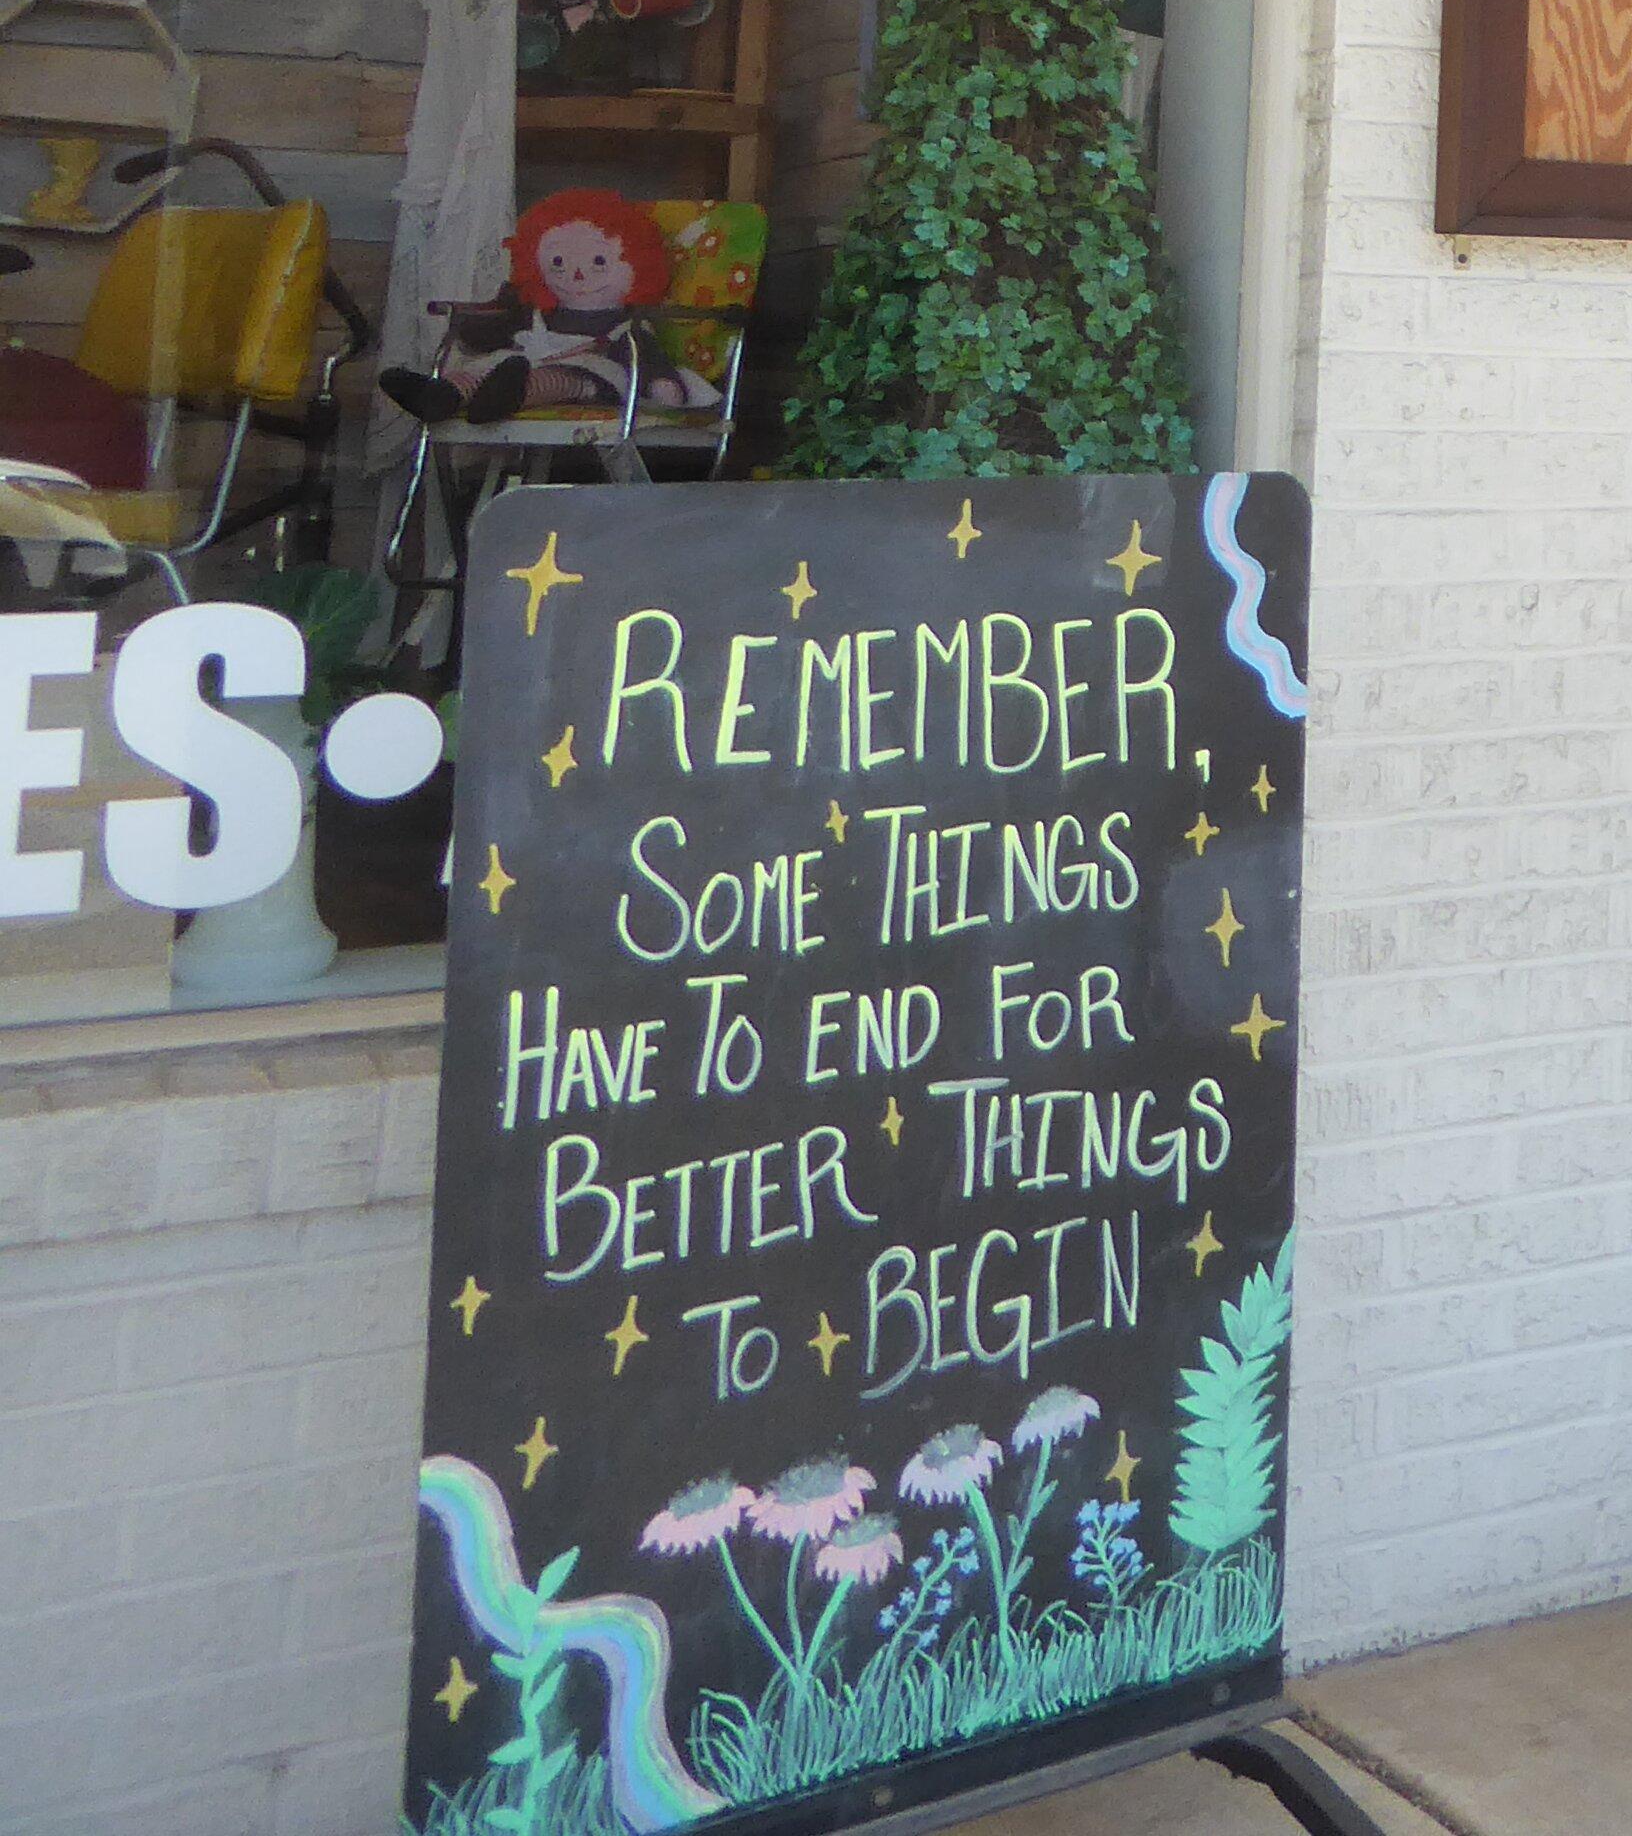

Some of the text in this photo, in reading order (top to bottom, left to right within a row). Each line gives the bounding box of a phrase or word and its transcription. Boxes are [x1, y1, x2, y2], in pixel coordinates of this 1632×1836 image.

[602, 607, 1212, 783] REMEMBER,
[614, 804, 1140, 962] SOME THINGS
[498, 963, 1136, 1132] HAVE TO END FOR
[543, 1076, 1233, 1282] BETTER THINGS
[681, 1208, 1144, 1402] TO BEGIN
